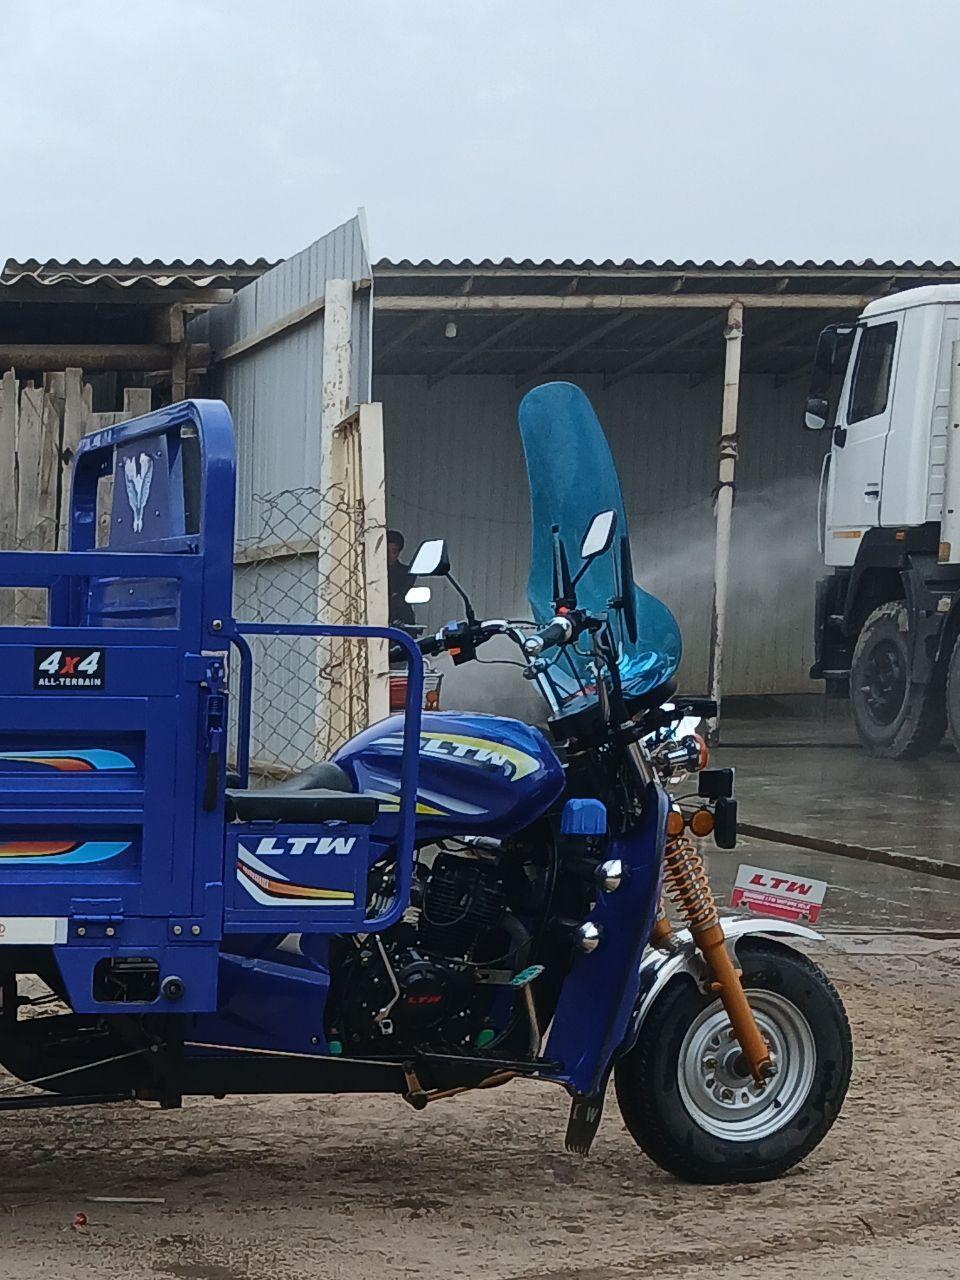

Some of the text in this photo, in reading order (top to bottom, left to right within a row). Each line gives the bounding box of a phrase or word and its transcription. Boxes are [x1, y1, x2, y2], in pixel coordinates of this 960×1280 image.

[38, 677, 102, 686] ALL-TERRAIN
[423, 739, 508, 767] LTW
[255, 837, 357, 855] LTW
[748, 873, 813, 896] LTW
